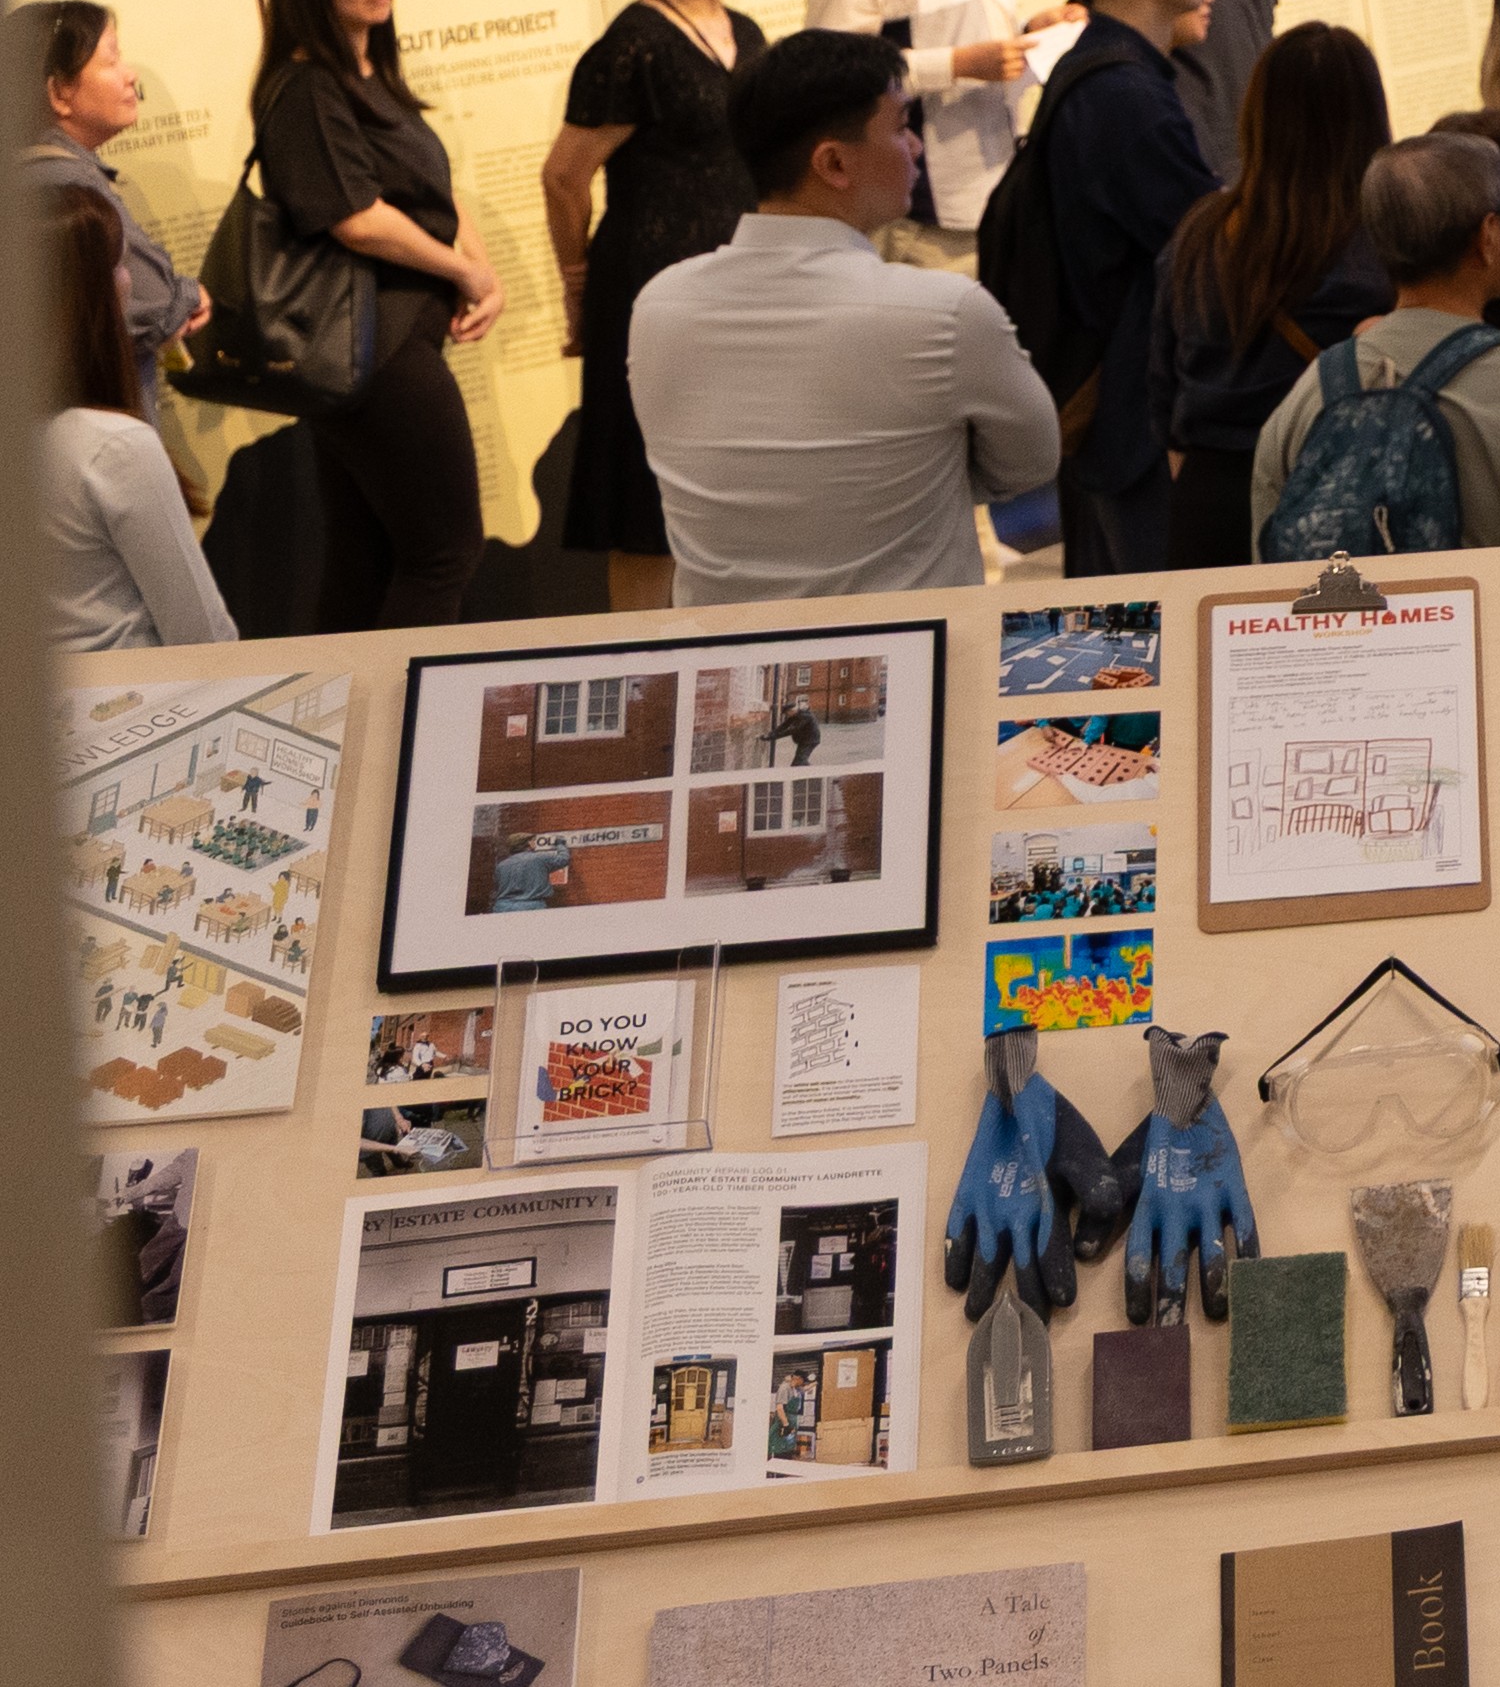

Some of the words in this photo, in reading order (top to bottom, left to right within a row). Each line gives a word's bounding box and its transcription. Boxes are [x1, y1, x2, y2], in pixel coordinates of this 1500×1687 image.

[485, 10, 558, 40] PROJECT
[1228, 613, 1348, 636] HEALTHY
[560, 1019, 593, 1036] DO
[600, 1013, 647, 1032] YOU
[565, 1036, 639, 1057] KNOW
[569, 1059, 631, 1078] YOUR
[558, 1081, 638, 1102] BRICK?
[652, 1176, 707, 1190] BOUNDARY
[751, 1175, 813, 1183] COMMUNITY
[817, 1169, 882, 1181] LAUNDRETTE
[394, 1213, 465, 1230] ESTATE
[473, 1196, 597, 1220] COMMUNITY
[280, 1614, 334, 1630] Guidebook
[337, 1612, 347, 1621] to
[350, 1604, 418, 1620] Self-Assisted
[419, 1599, 474, 1613] Unbuilding
[319, 1600, 356, 1613] against
[358, 1594, 409, 1607] Diamonds
[980, 1597, 997, 1616] A
[1004, 1592, 1051, 1615] Tale
[1411, 1569, 1444, 1672] Book
[1028, 1622, 1048, 1646] of
[922, 1663, 972, 1683] Two
[981, 1653, 1050, 1677] Panels
